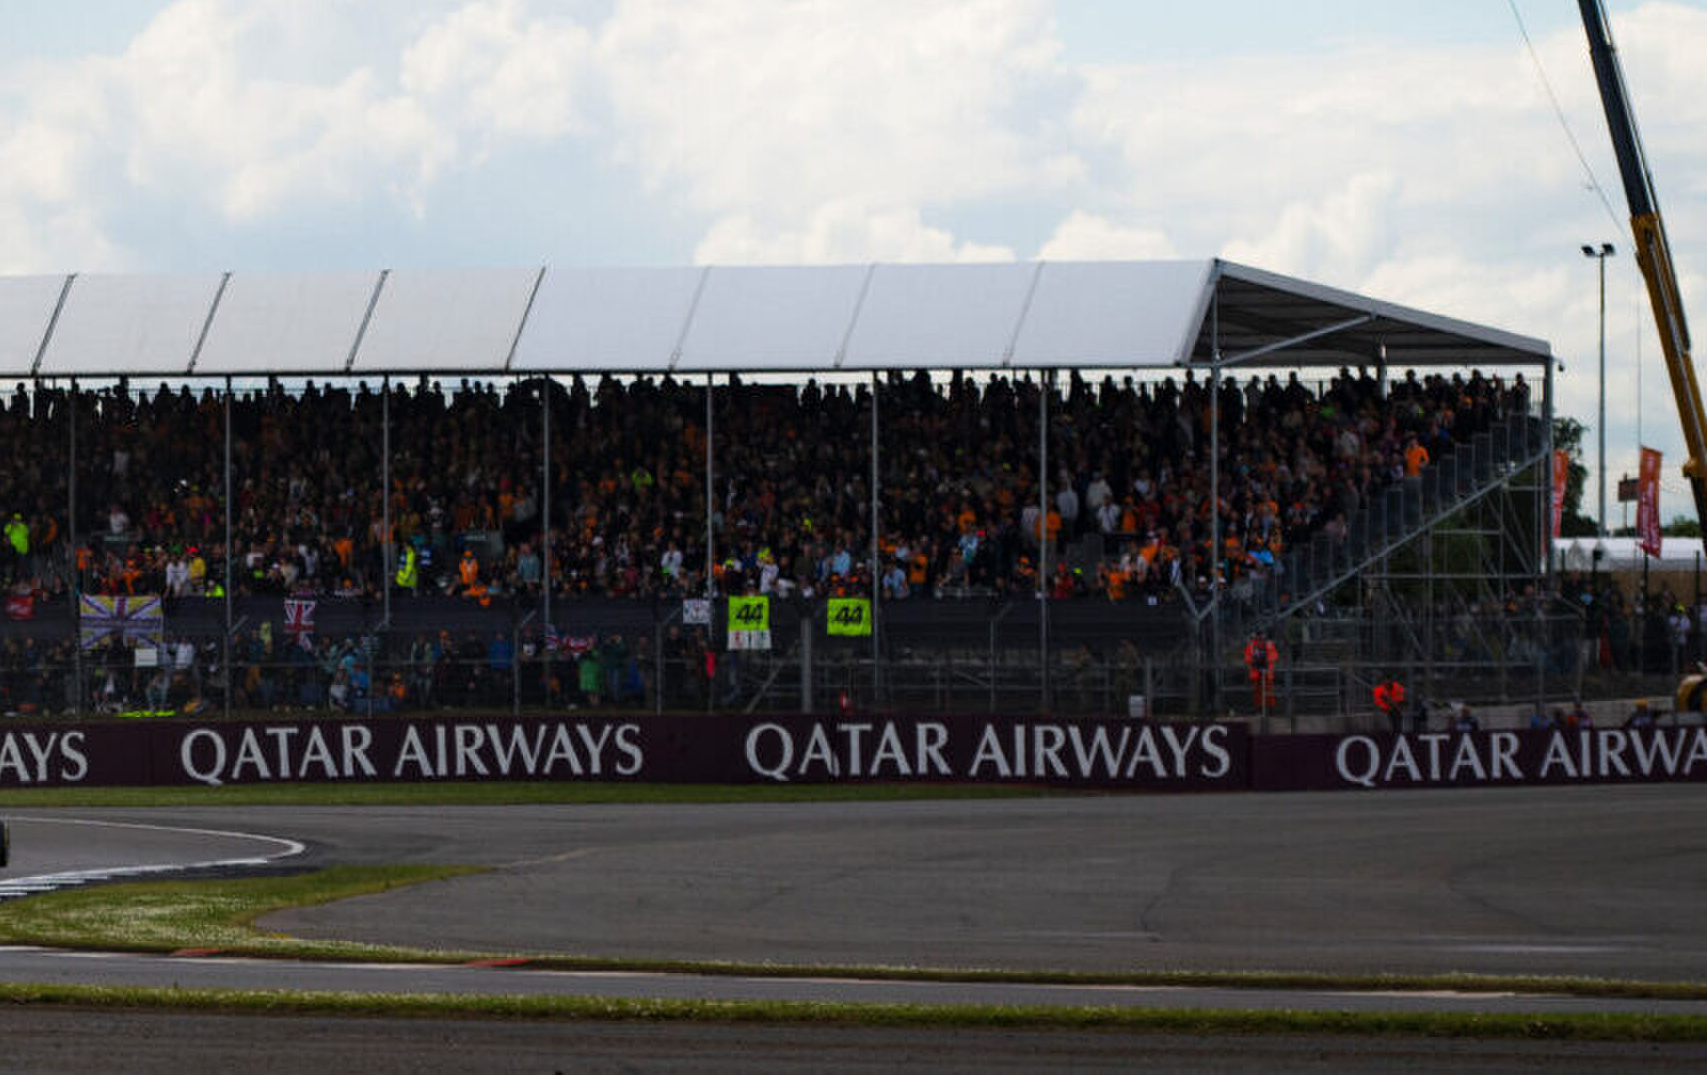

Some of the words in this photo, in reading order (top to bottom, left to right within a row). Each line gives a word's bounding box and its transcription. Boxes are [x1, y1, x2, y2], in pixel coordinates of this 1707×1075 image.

[737, 603, 764, 623] 44
[835, 606, 862, 625] 44
[182, 726, 378, 785] QATAR
[394, 723, 644, 777] AIRWAYS
[745, 722, 952, 781] QATAR
[969, 724, 1231, 778] AIRWAYS
[1336, 731, 1524, 787] QATAR
